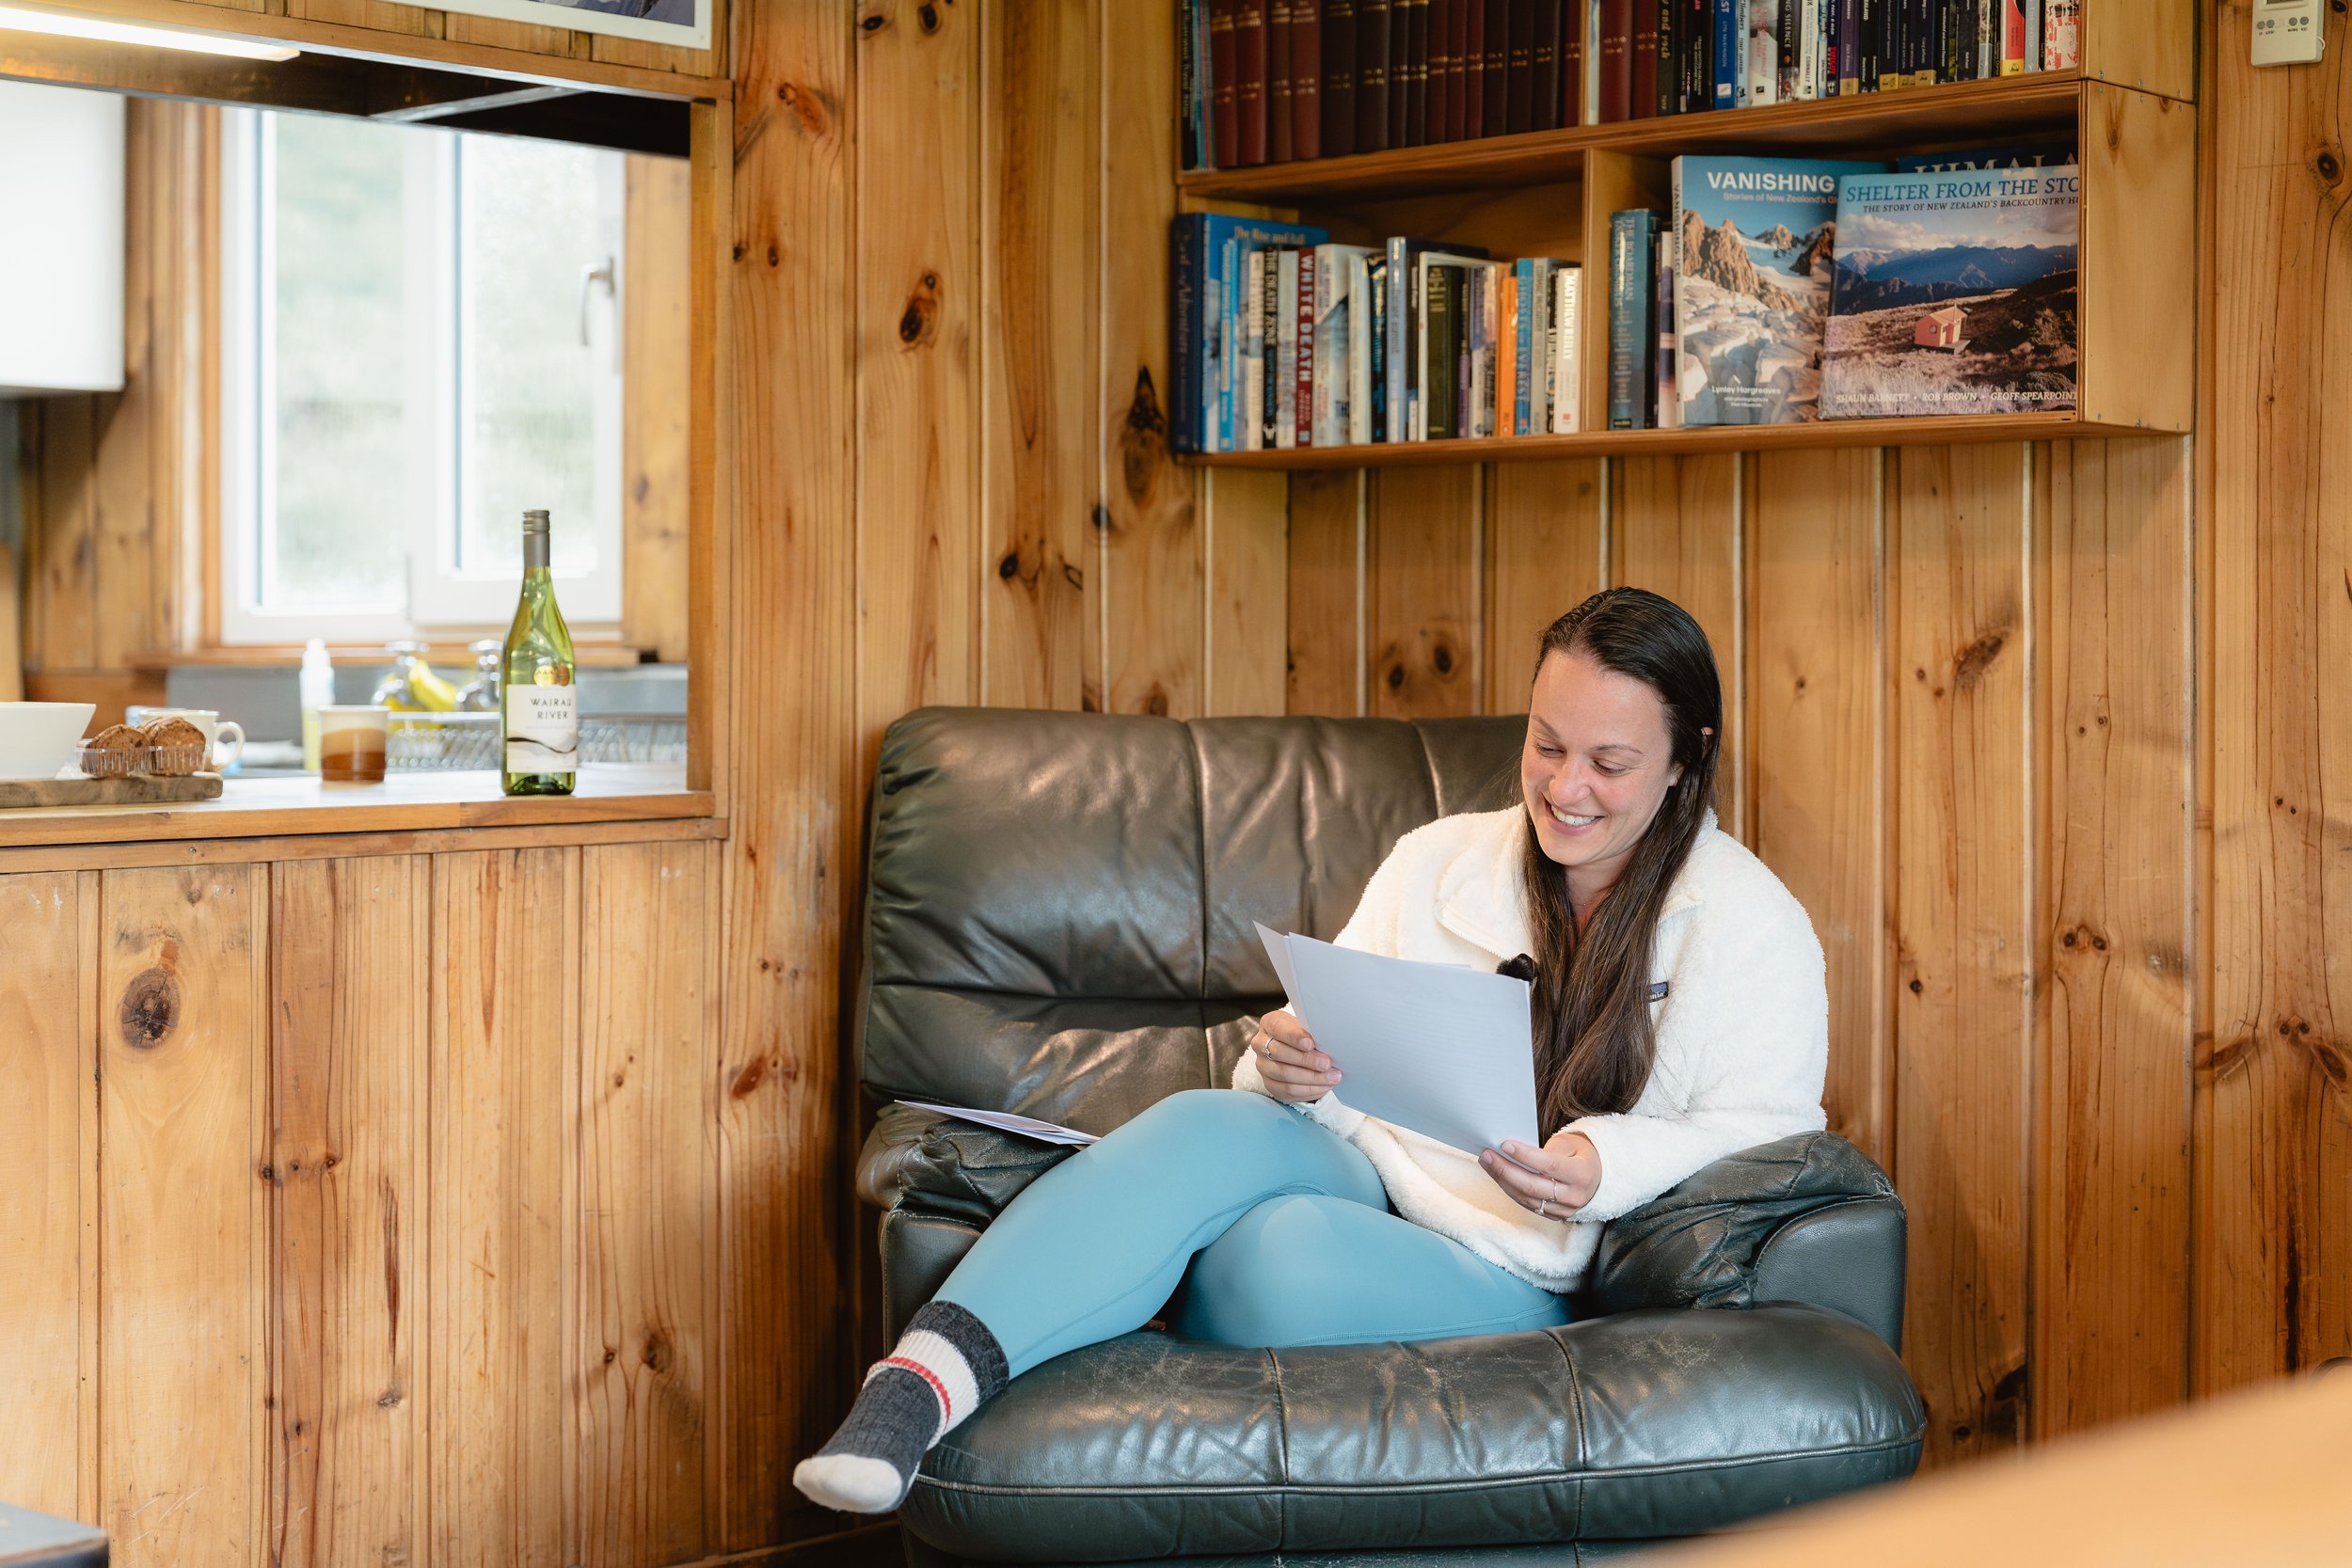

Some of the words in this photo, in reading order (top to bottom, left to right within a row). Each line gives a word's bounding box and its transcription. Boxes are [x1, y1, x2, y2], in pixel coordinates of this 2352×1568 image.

[1661, 9, 1672, 30] and
[1784, 14, 1792, 48] SILENCE
[1661, 35, 1671, 59] rock
[1707, 171, 1835, 193] VANISHING
[1846, 183, 1930, 202] SHELTER
[1934, 181, 1992, 199] FROM
[1997, 178, 2039, 196] THE
[1724, 192, 1755, 201] Stories
[1766, 194, 1786, 202] New
[1863, 204, 1881, 214] THE
[1883, 203, 1911, 213] STORY
[1913, 202, 1927, 212] OF
[1928, 201, 1948, 212] NEW
[1949, 199, 1998, 210] ZEALAND'S
[1999, 197, 2067, 208] BACKCOUNTRY
[1625, 216, 1635, 237] THE
[1674, 183, 1682, 254] VANISHING
[1264, 249, 1277, 272] THE
[1625, 240, 1635, 300] BOARDMAN
[1264, 273, 1277, 313] DEATH
[1299, 253, 1314, 316] WHITE
[1563, 273, 1578, 325] MATTHEW
[1264, 314, 1277, 347] ZONE
[1299, 321, 1313, 383] DEATH
[1563, 326, 1574, 360] REILLY
[1712, 386, 1736, 395] Lynley
[1737, 386, 1781, 395] Hargreaves
[1836, 394, 1867, 404] SHAUN
[1868, 393, 1912, 404] BARNETT
[1922, 392, 1942, 403] ROB
[1943, 391, 1978, 402] BROWN
[1991, 390, 2021, 402] GEOFF
[537, 711, 567, 720] RIVER
